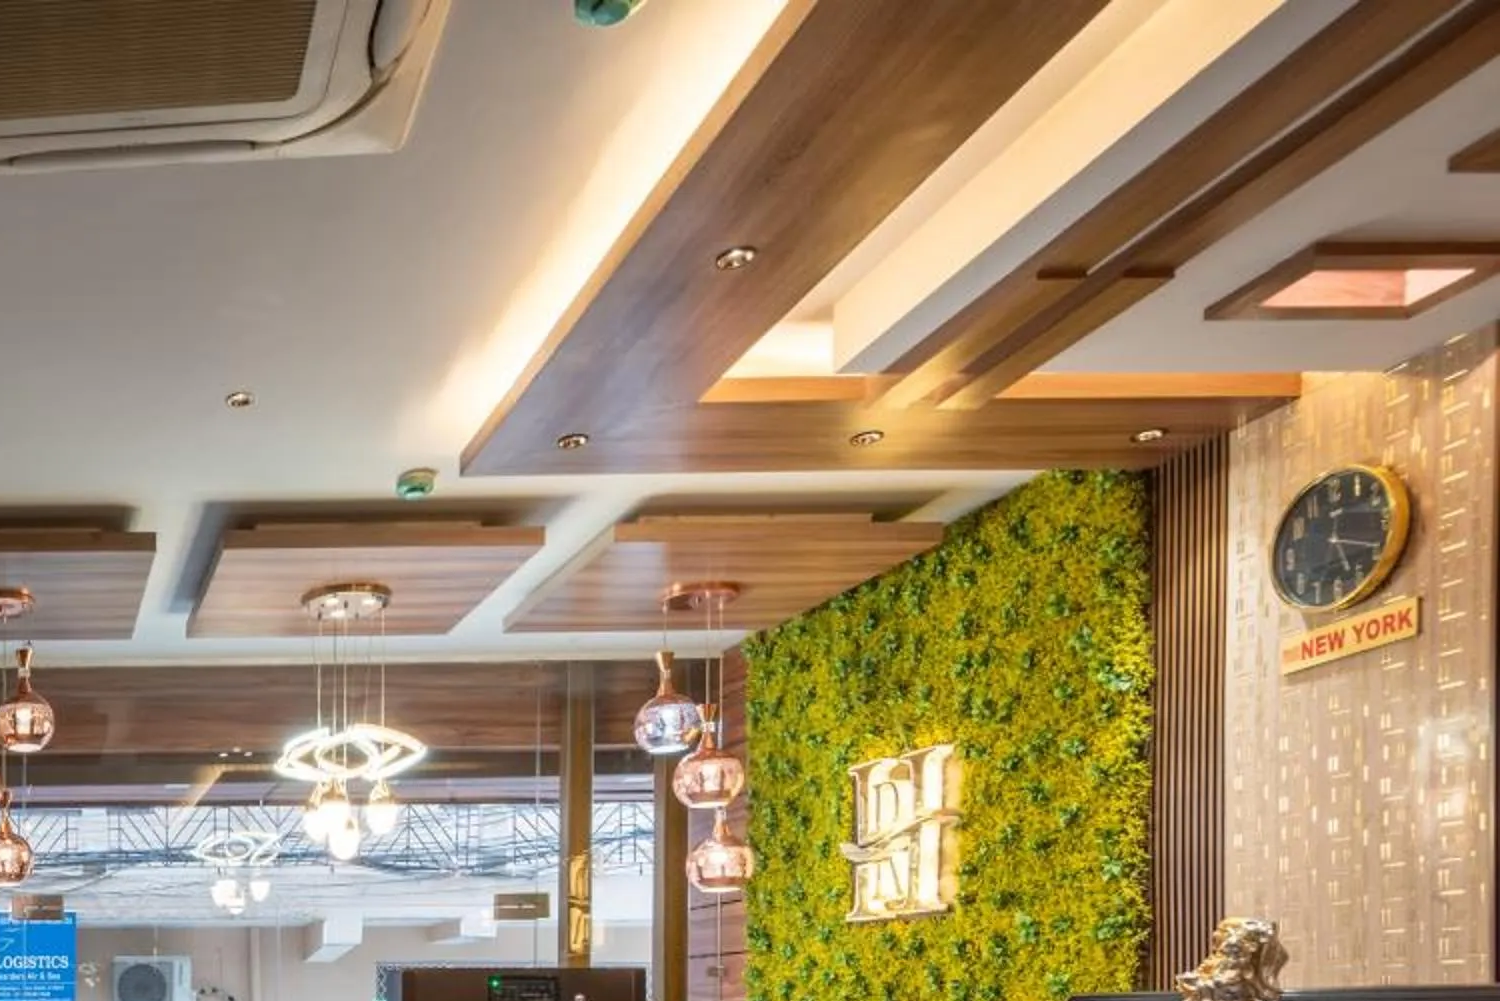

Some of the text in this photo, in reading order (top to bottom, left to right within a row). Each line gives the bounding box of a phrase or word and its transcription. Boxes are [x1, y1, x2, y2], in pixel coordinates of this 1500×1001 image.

[1310, 580, 1321, 605] 7
[1300, 607, 1413, 661] NEW YORK
